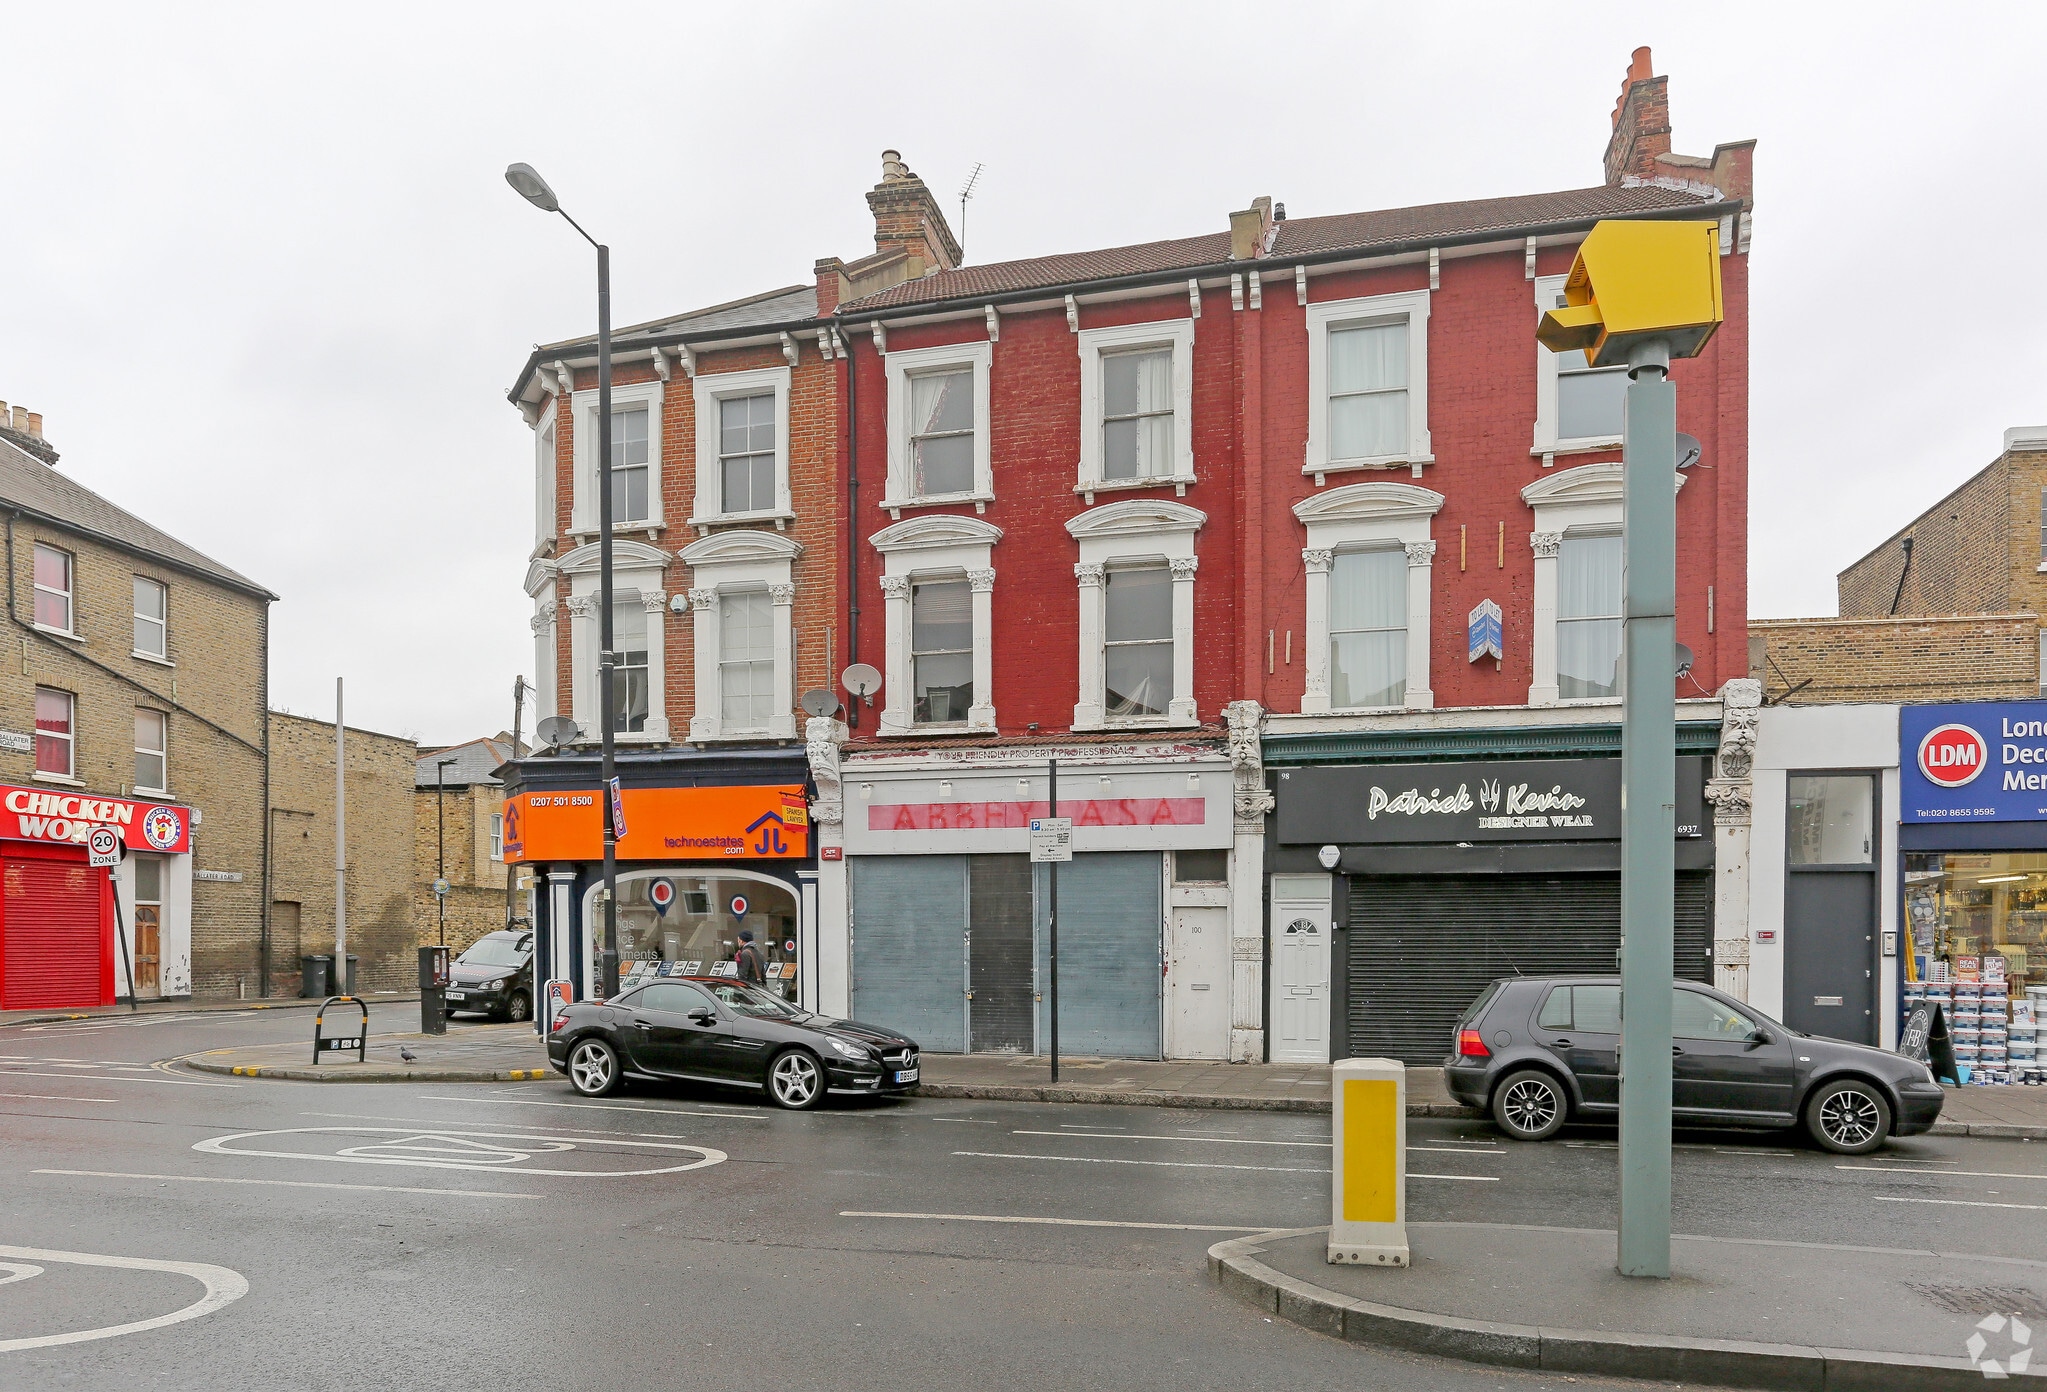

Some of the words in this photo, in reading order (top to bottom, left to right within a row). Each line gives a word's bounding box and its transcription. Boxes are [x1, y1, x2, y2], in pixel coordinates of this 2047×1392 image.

[965, 750, 1007, 759] FRIENDLY
[1009, 748, 1057, 758] PROPERTY
[1928, 743, 1976, 767] LDM
[1281, 772, 1290, 780] 98
[530, 797, 552, 807] 0207
[553, 797, 569, 806] 501
[571, 796, 593, 806] 8500
[1368, 783, 1474, 821] Patrick
[1506, 783, 1586, 815] Kevin
[5, 790, 135, 825] CHICKEN
[786, 807, 803, 816] SPANISH
[1916, 809, 1948, 818] Tel:020
[1949, 808, 1971, 817] 8655
[1973, 807, 1996, 816] 9595
[786, 815, 804, 824] LAWYER
[1478, 816, 1549, 829] DESIGNER
[1549, 815, 1594, 827] WEAR
[19, 814, 126, 844] WORD
[1677, 824, 1698, 833] 6937
[94, 836, 113, 847] 20
[664, 836, 745, 848] technoestates
[723, 846, 745, 854] .com
[93, 855, 117, 864] ZONE
[1191, 926, 1202, 934] 100
